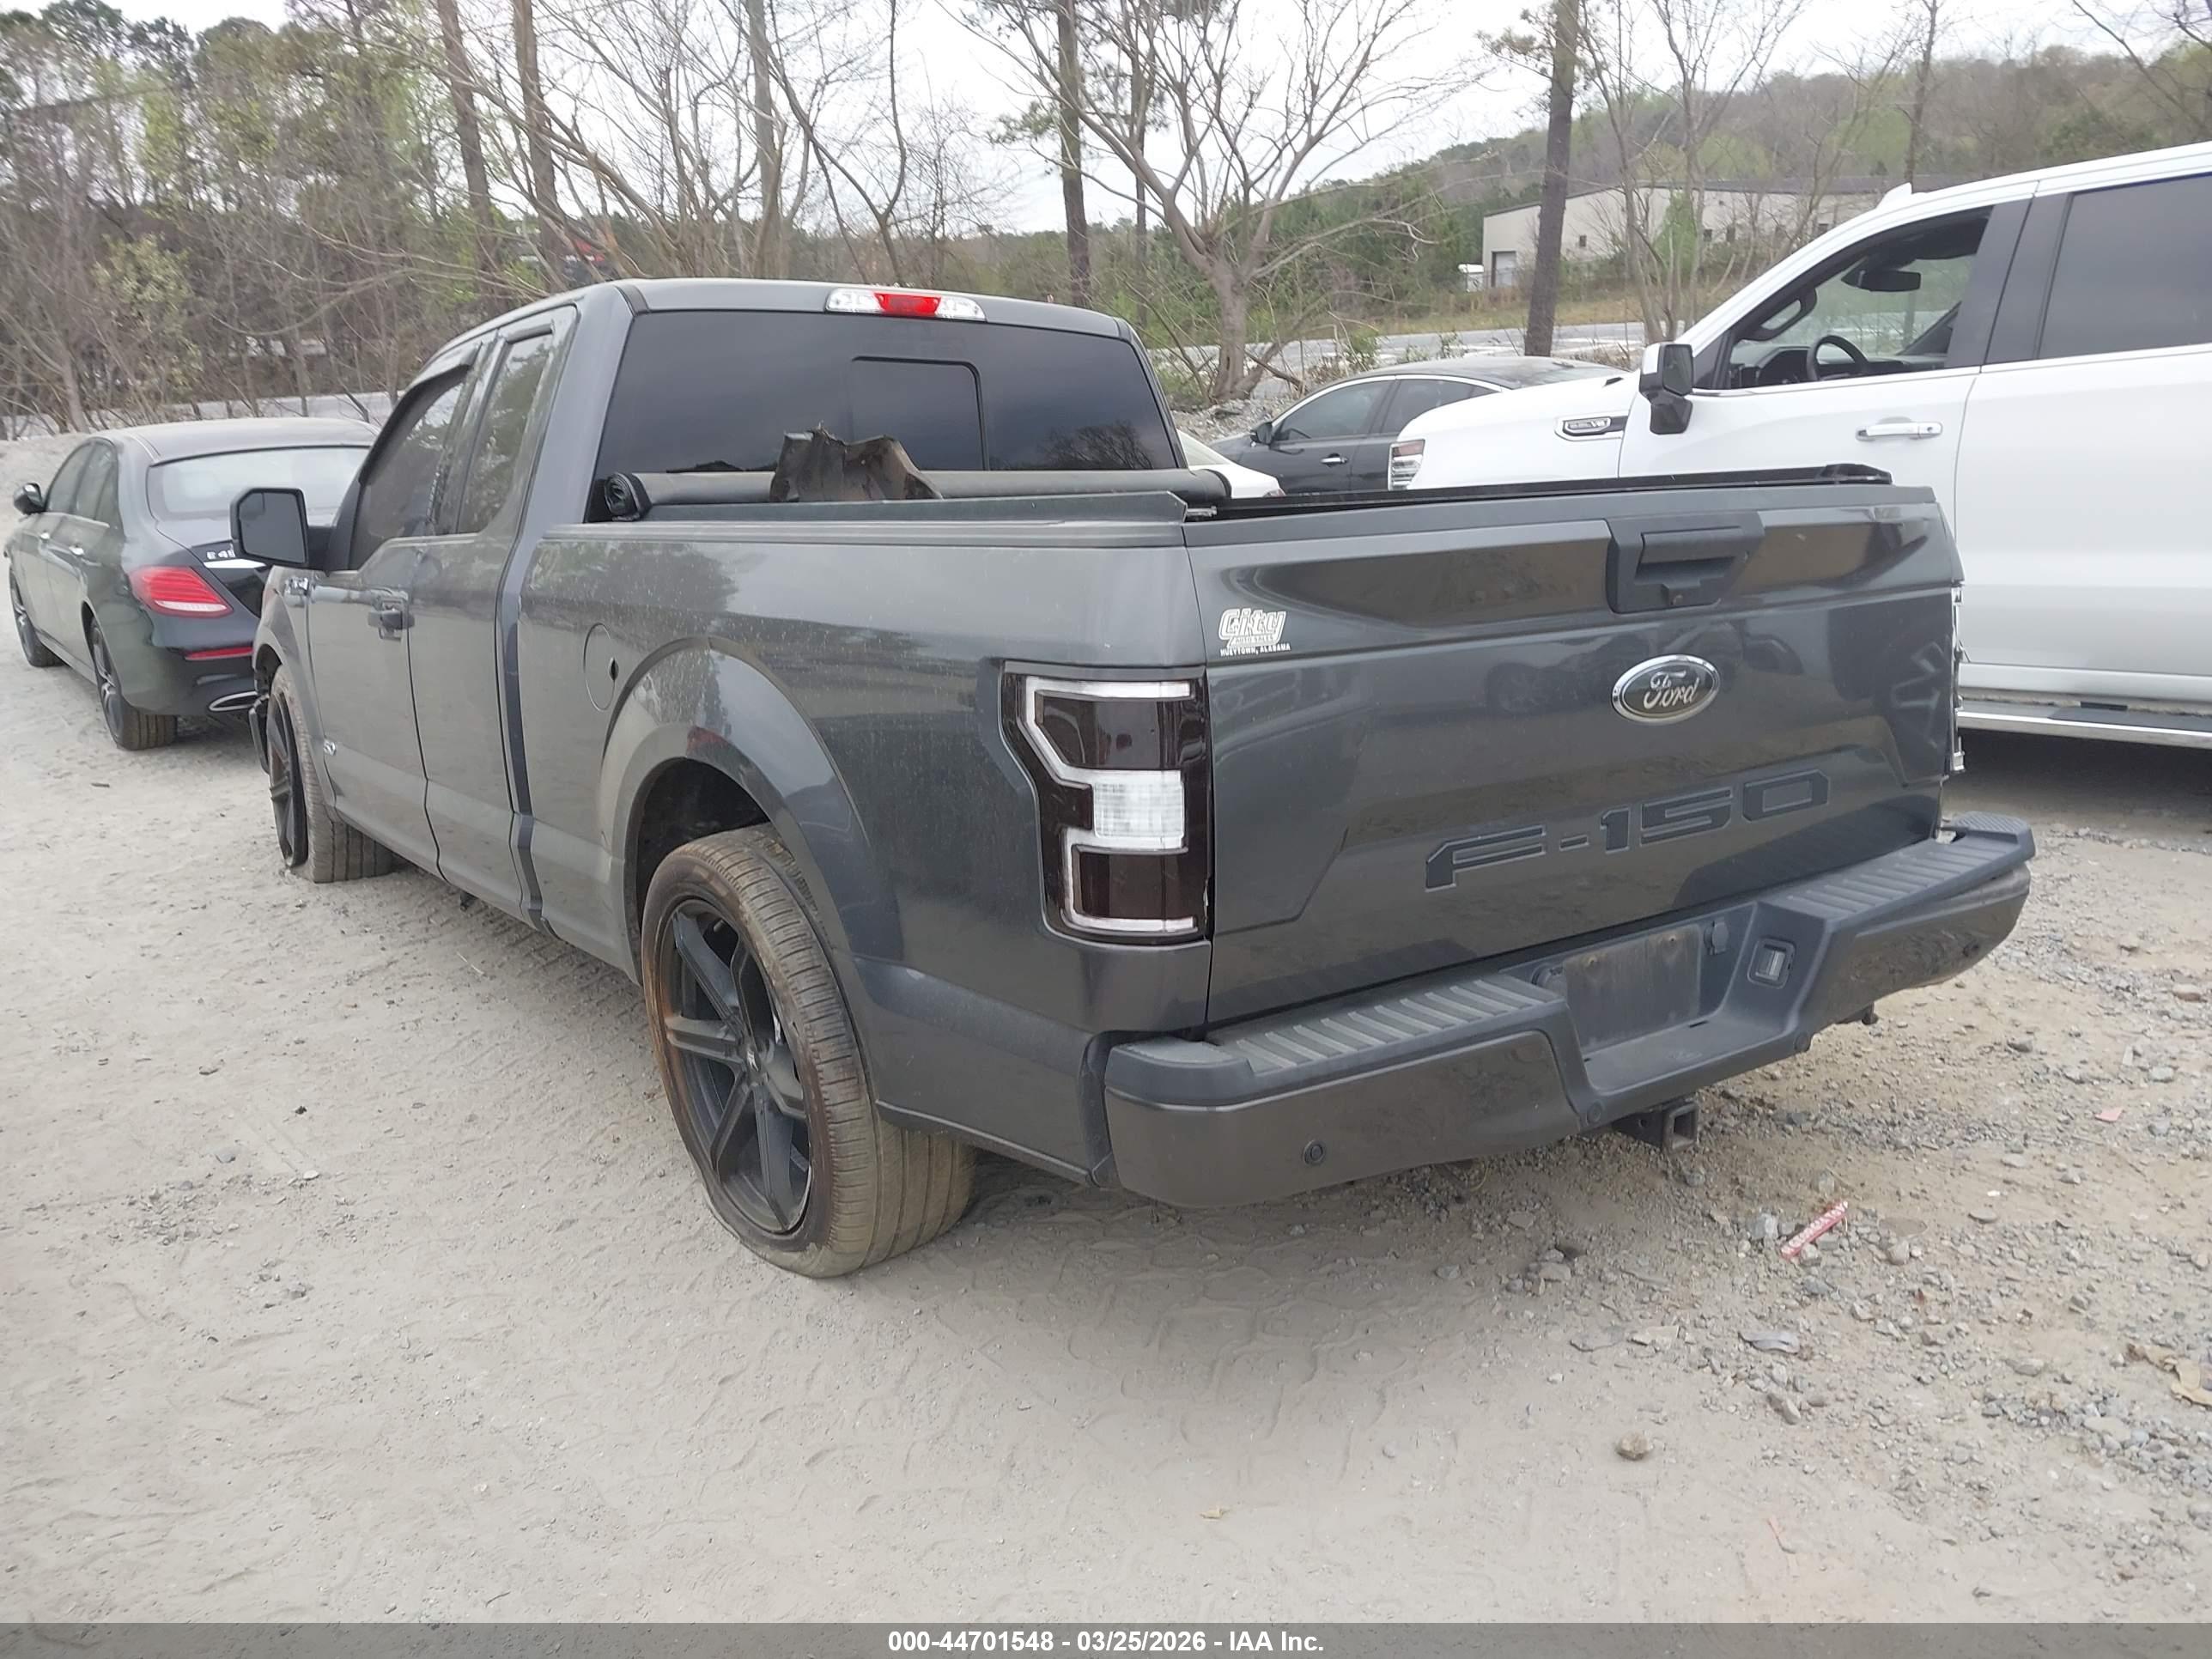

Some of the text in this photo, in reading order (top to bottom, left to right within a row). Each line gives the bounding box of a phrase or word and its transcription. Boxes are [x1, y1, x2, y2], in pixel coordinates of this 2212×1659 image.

[1218, 608, 1286, 647] City
[1220, 642, 1291, 657] HUEYTOWN, ALABAMA
[1643, 670, 1699, 709] Ford
[1425, 769, 1830, 893] F-150
